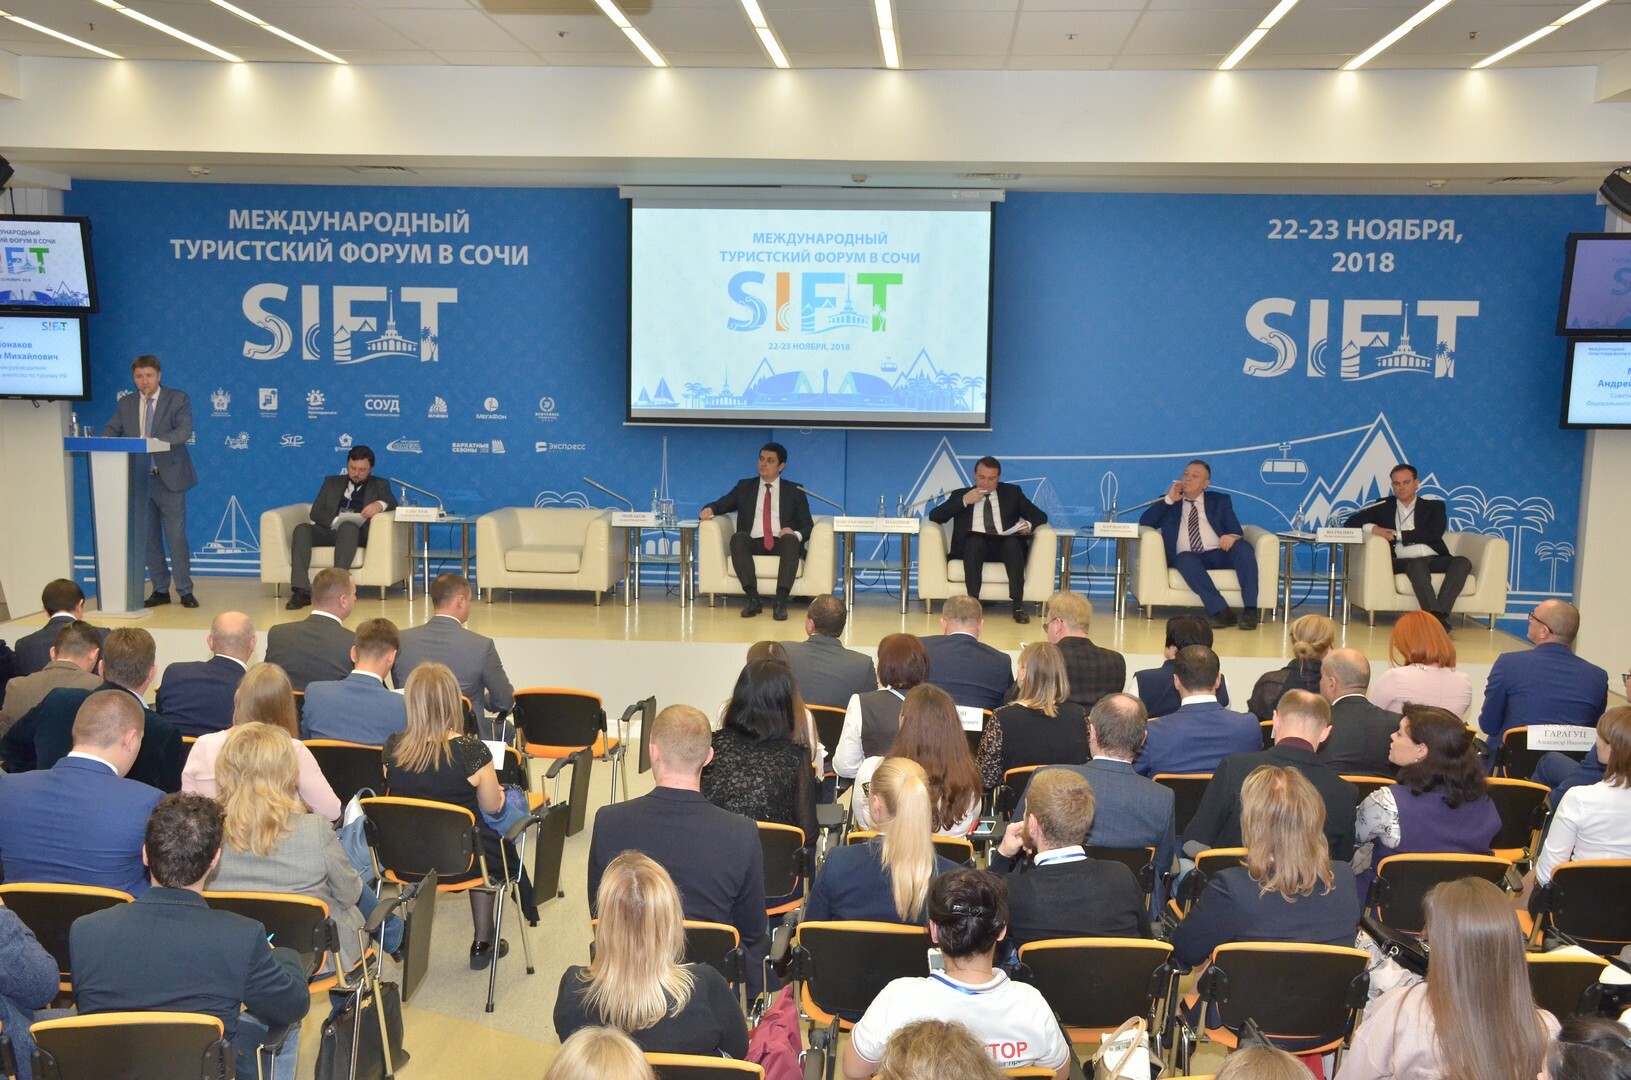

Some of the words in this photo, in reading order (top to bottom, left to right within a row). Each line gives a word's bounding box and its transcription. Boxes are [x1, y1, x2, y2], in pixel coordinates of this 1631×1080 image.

[229, 209, 470, 236] МЕЖДУНАРОДНЫЙ
[1267, 219, 1339, 240] 22-23
[1347, 219, 1463, 243] НОЯБРЯ,
[752, 231, 889, 246] МЕЖДУНАРОДНЫЙ
[170, 238, 334, 263] ТУРИСТСКИЙ
[339, 242, 432, 264] ФОРУМ
[439, 244, 453, 265] В
[459, 244, 529, 266] СОЧИ
[719, 249, 811, 264] ТУРИСТСКИЙ
[814, 251, 866, 264] ФОРУМ
[869, 251, 879, 264] В
[881, 251, 921, 265] СОЧИ
[1331, 252, 1395, 273] 2018
[726, 270, 903, 334] SIFT
[242, 283, 458, 364] SIFT
[768, 342, 791, 352] 22-23
[792, 342, 829, 353] НОЯБРЯ,
[830, 342, 851, 352] 2018
[1242, 297, 1480, 381] SIFT
[4, 352, 58, 360] Михайлович
[364, 399, 400, 413] СОУД
